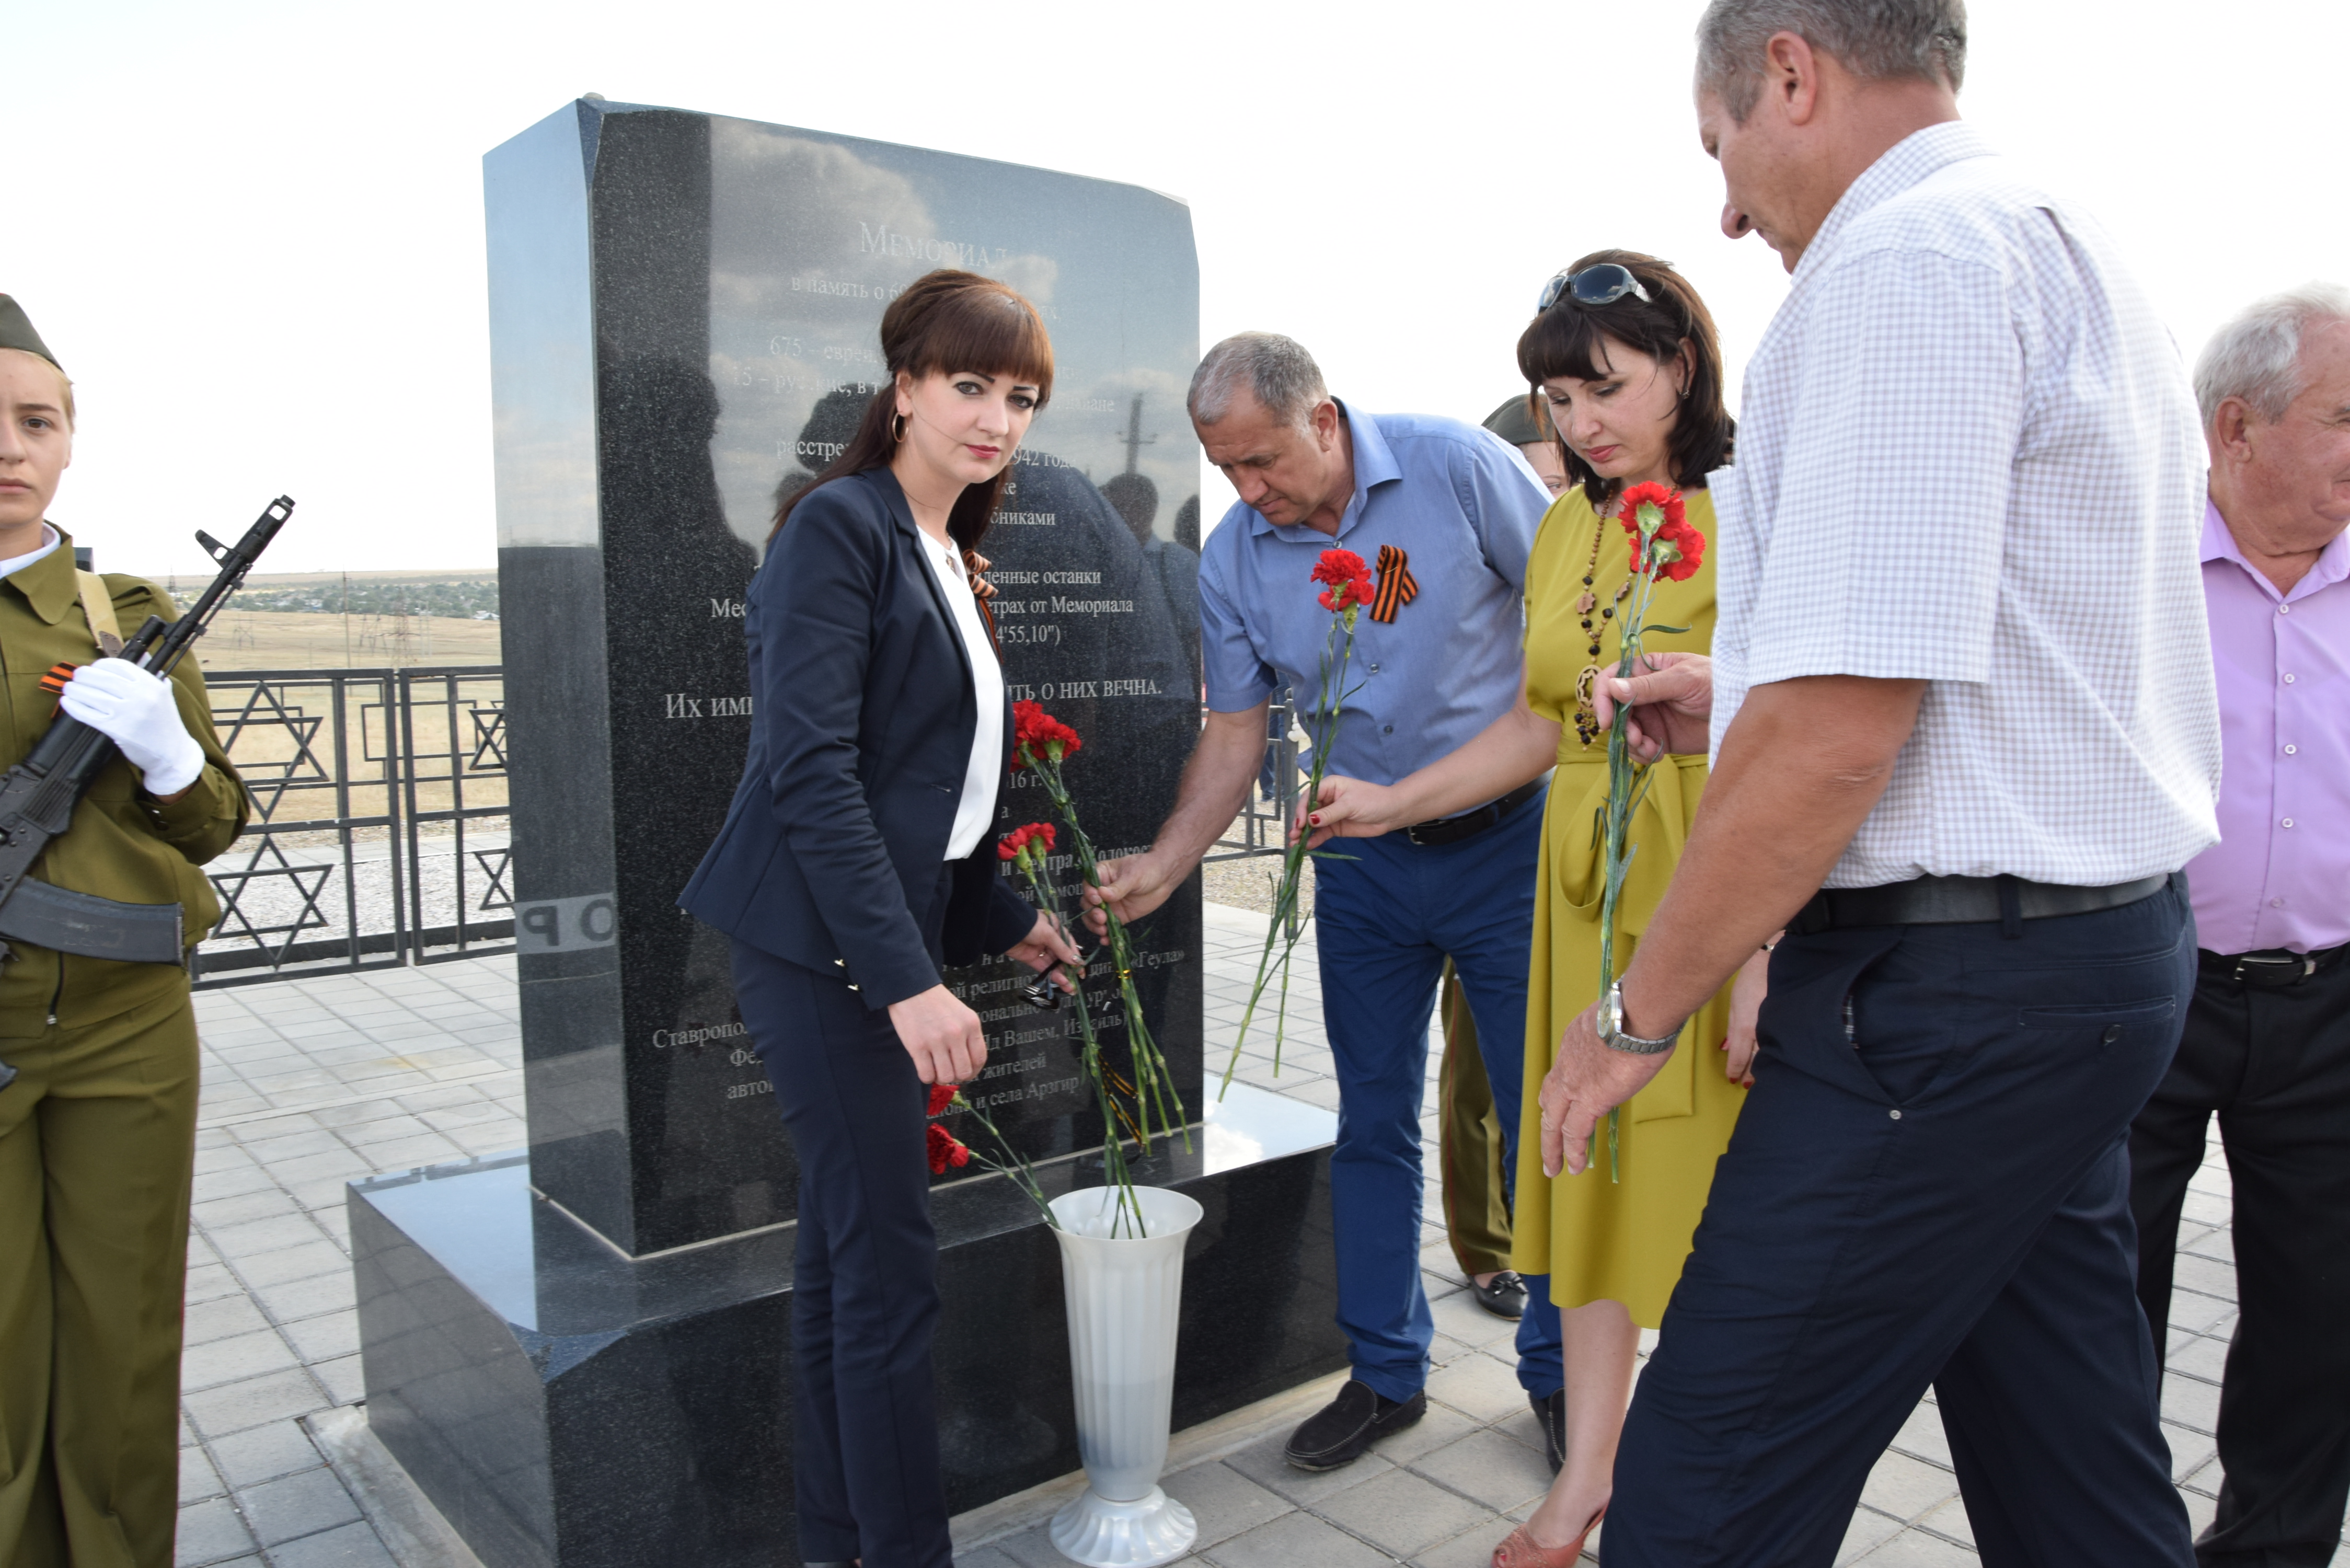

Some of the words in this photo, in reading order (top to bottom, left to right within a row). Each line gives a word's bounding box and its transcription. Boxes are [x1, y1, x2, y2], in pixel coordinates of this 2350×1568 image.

[792, 278, 801, 291] в
[807, 280, 868, 298] память
[874, 286, 884, 299] о
[770, 336, 802, 356] 675
[857, 381, 866, 394] в
[776, 440, 846, 462] расстре
[1012, 448, 1039, 466] 942
[989, 506, 1056, 526] бниками
[1043, 571, 1102, 584] останки
[986, 601, 1026, 619] етрах
[1031, 601, 1047, 614] от
[1051, 596, 1134, 617] Мемориала
[996, 625, 1061, 646] 4'55,10")
[1059, 681, 1098, 699] НИХ
[1102, 679, 1162, 697] ВЕЧНА.
[1010, 770, 1027, 789] 16
[1031, 774, 1042, 787] г.
[1016, 854, 1073, 876] етра
[1131, 949, 1185, 970] «Геула»
[652, 1022, 748, 1048] Ставропо
[970, 974, 1039, 1001] религио
[978, 1003, 1042, 1022] онально
[1004, 1026, 1059, 1047] Вашем,
[1064, 1013, 1128, 1042] Изаиль)
[983, 1052, 1047, 1079] жителей
[989, 1088, 1023, 1106] села
[1026, 1076, 1080, 1101] Арзгир
